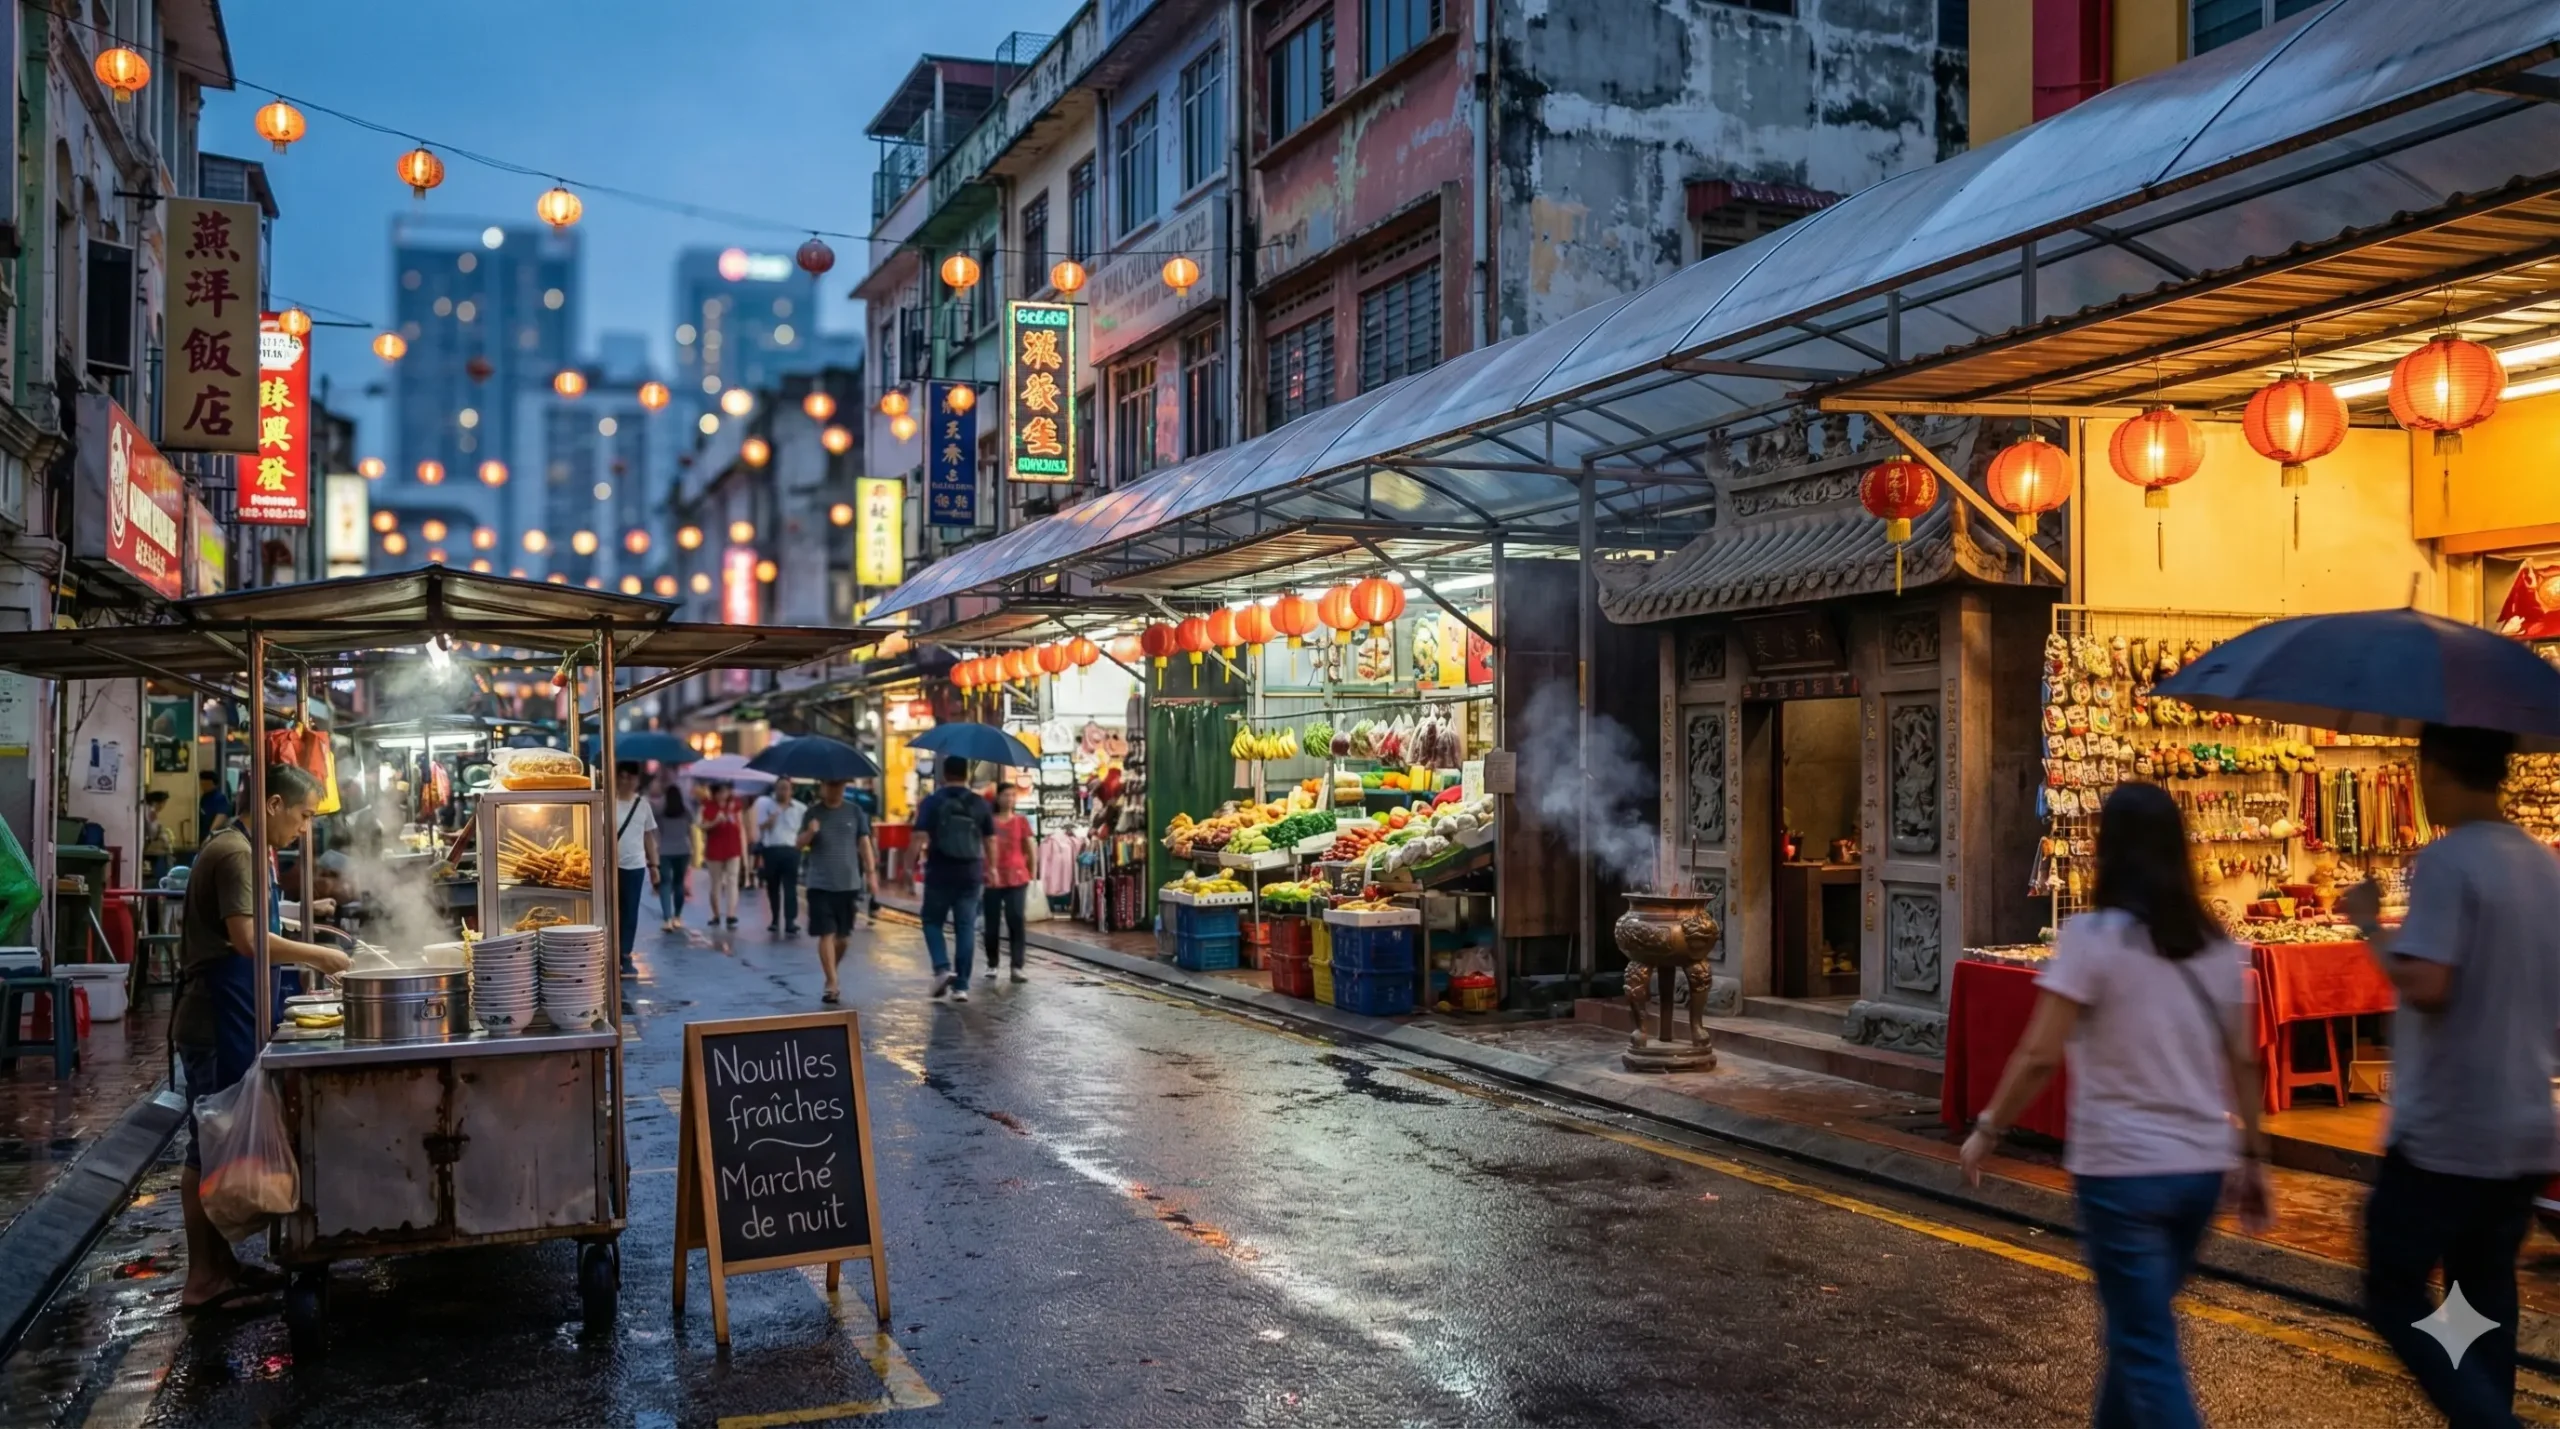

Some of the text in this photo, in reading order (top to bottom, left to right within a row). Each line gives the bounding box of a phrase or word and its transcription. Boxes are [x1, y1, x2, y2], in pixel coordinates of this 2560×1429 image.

[713, 1040, 837, 1087] Nouilles
[725, 1089, 844, 1144] fraîches
[721, 1152, 836, 1201] Marché
[741, 1193, 847, 1240] de nuit
